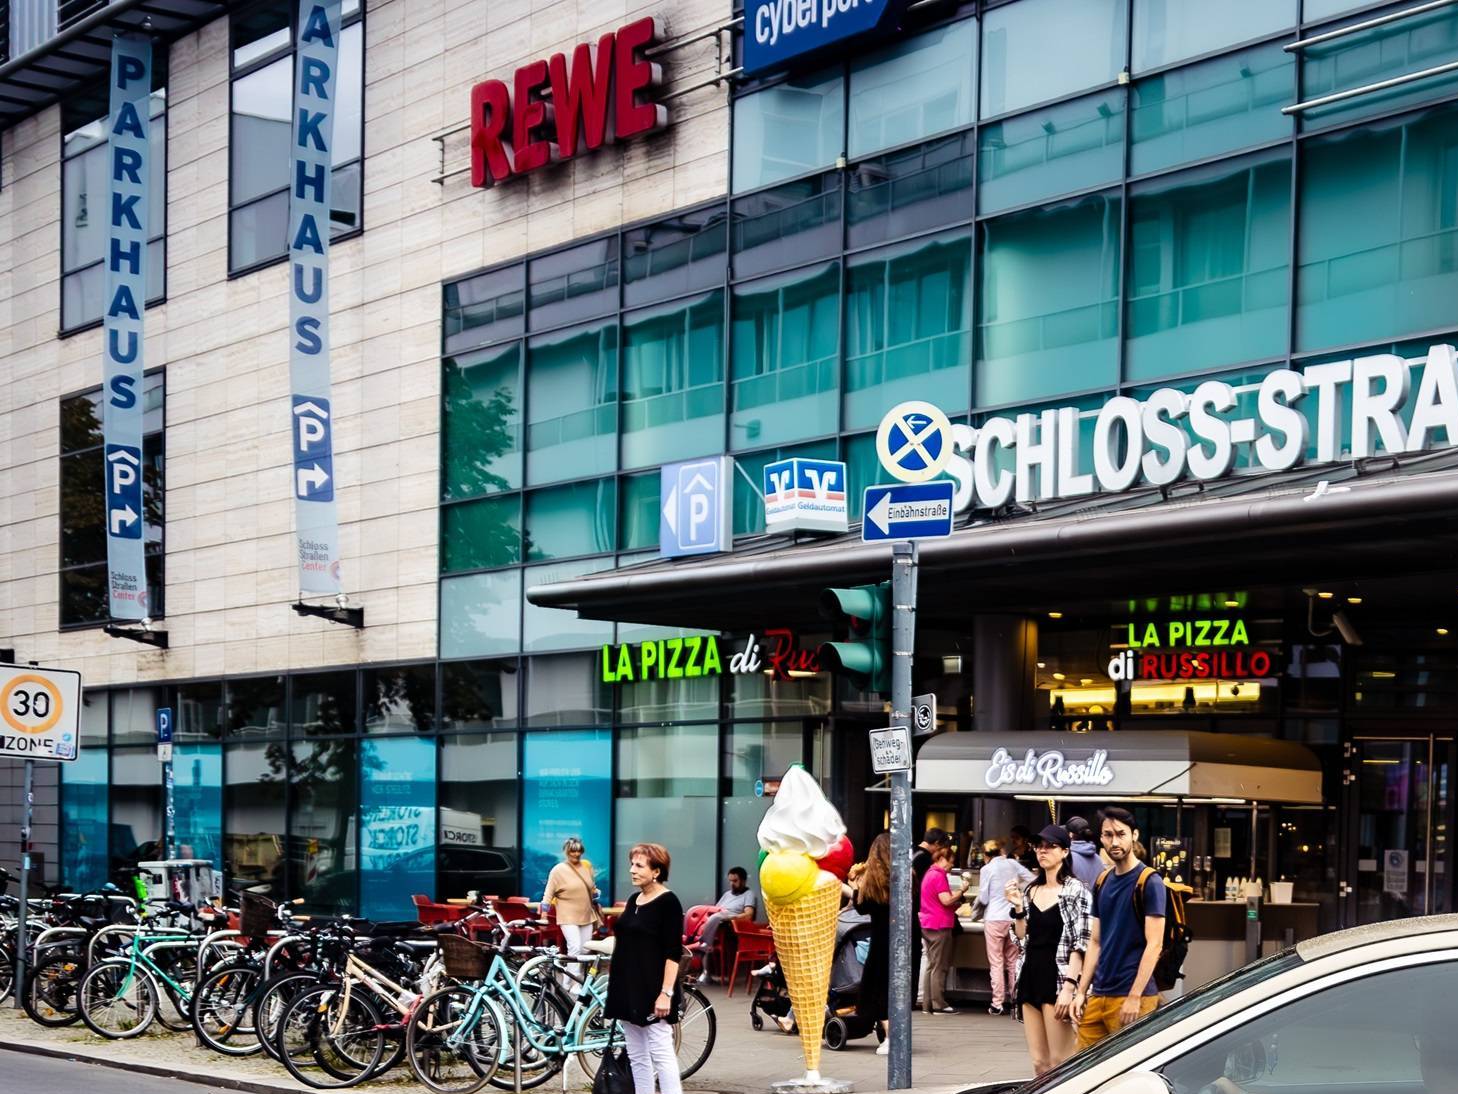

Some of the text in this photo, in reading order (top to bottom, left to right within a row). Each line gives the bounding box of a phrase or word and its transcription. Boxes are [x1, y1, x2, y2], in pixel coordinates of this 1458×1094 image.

[755, 0, 873, 46] cyberp
[471, 16, 660, 188] REWE
[293, 5, 335, 355] ARKHAUS
[107, 55, 145, 410] PARKHAUS
[299, 416, 325, 451] P
[113, 464, 136, 494] P
[690, 494, 709, 541] P
[797, 500, 845, 514] Geldautomat
[887, 504, 948, 520] Einbahnstraße
[1129, 619, 1249, 648] LA PIZZA
[602, 643, 634, 682] LA
[641, 635, 722, 680] PIZZA
[730, 633, 761, 674] di
[1108, 650, 1271, 681] di RUSSILLO
[13, 690, 50, 717] 30
